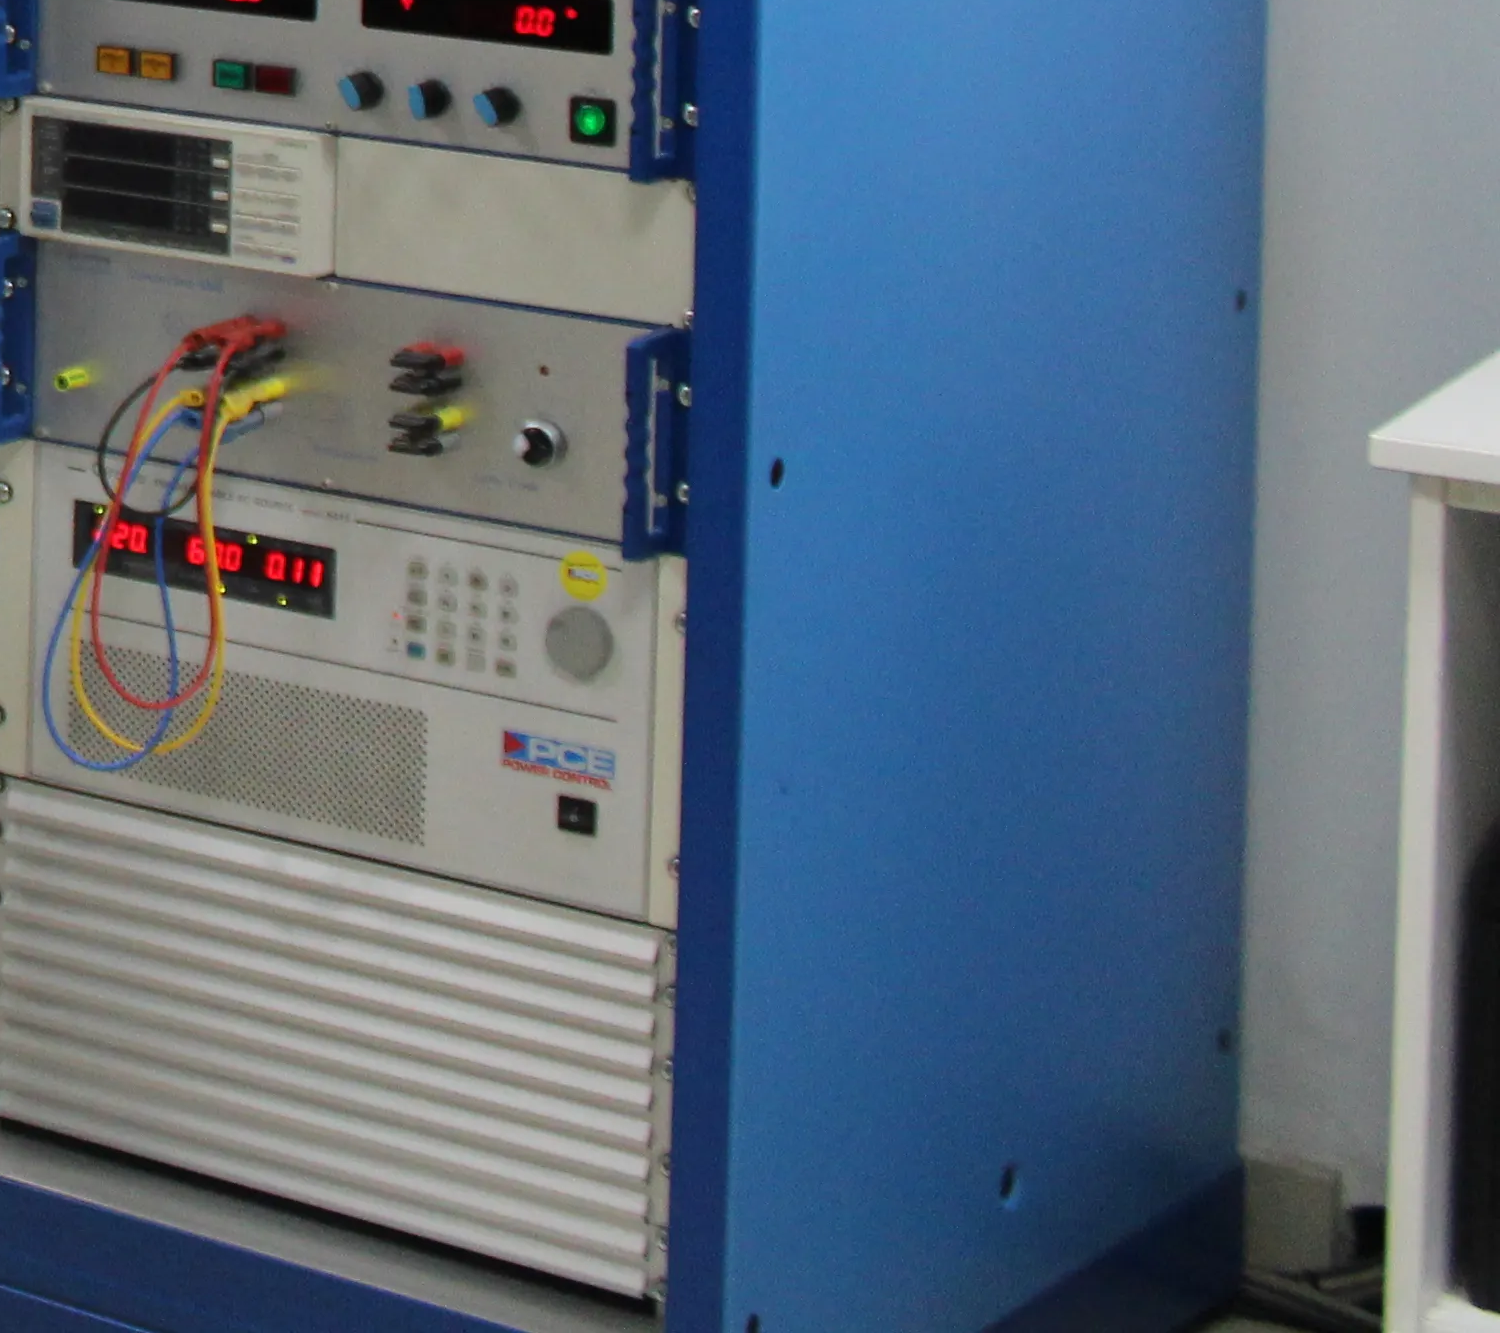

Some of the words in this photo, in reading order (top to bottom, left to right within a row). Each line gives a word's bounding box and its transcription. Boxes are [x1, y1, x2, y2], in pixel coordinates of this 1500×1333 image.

[502, 758, 550, 778] POWER
[553, 769, 612, 790] CONTROL
[529, 738, 615, 779] PCE
